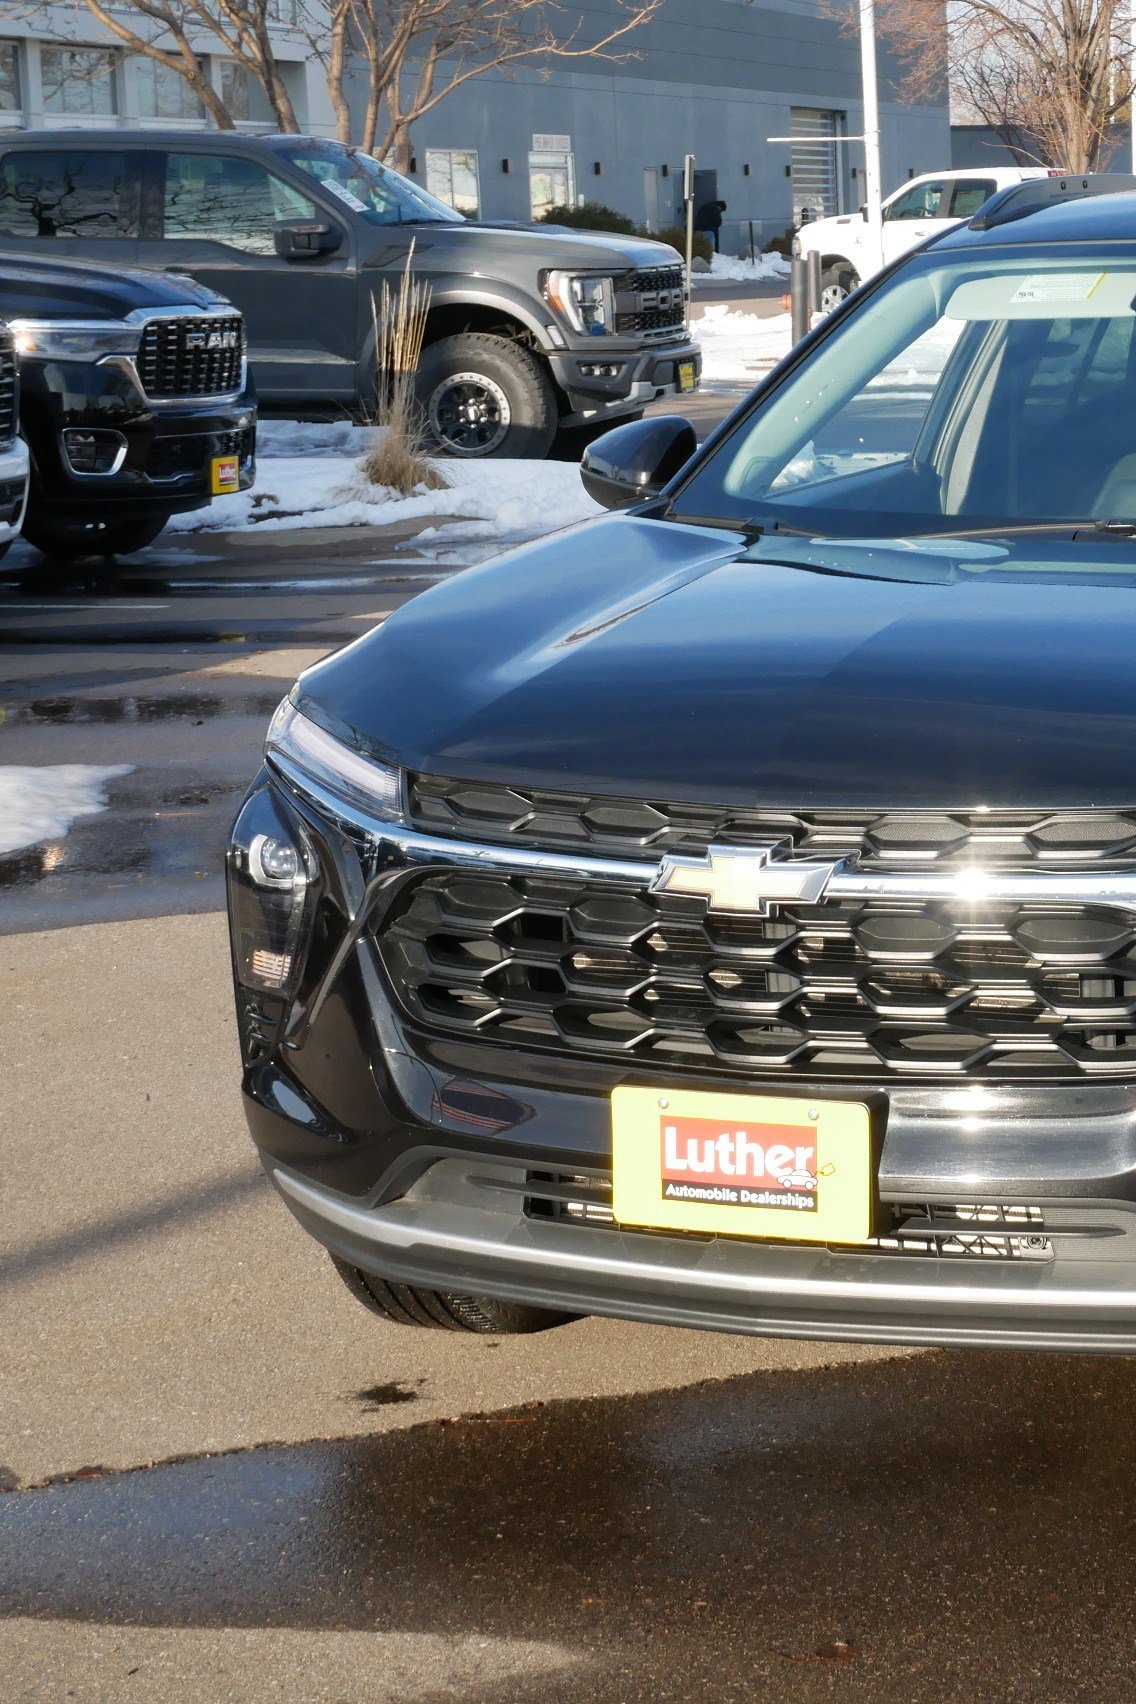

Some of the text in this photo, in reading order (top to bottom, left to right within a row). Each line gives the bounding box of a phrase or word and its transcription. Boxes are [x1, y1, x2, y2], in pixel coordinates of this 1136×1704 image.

[186, 332, 238, 350] RAM
[665, 1126, 814, 1179] Luther
[666, 1183, 814, 1208] Automobile Dealerships
